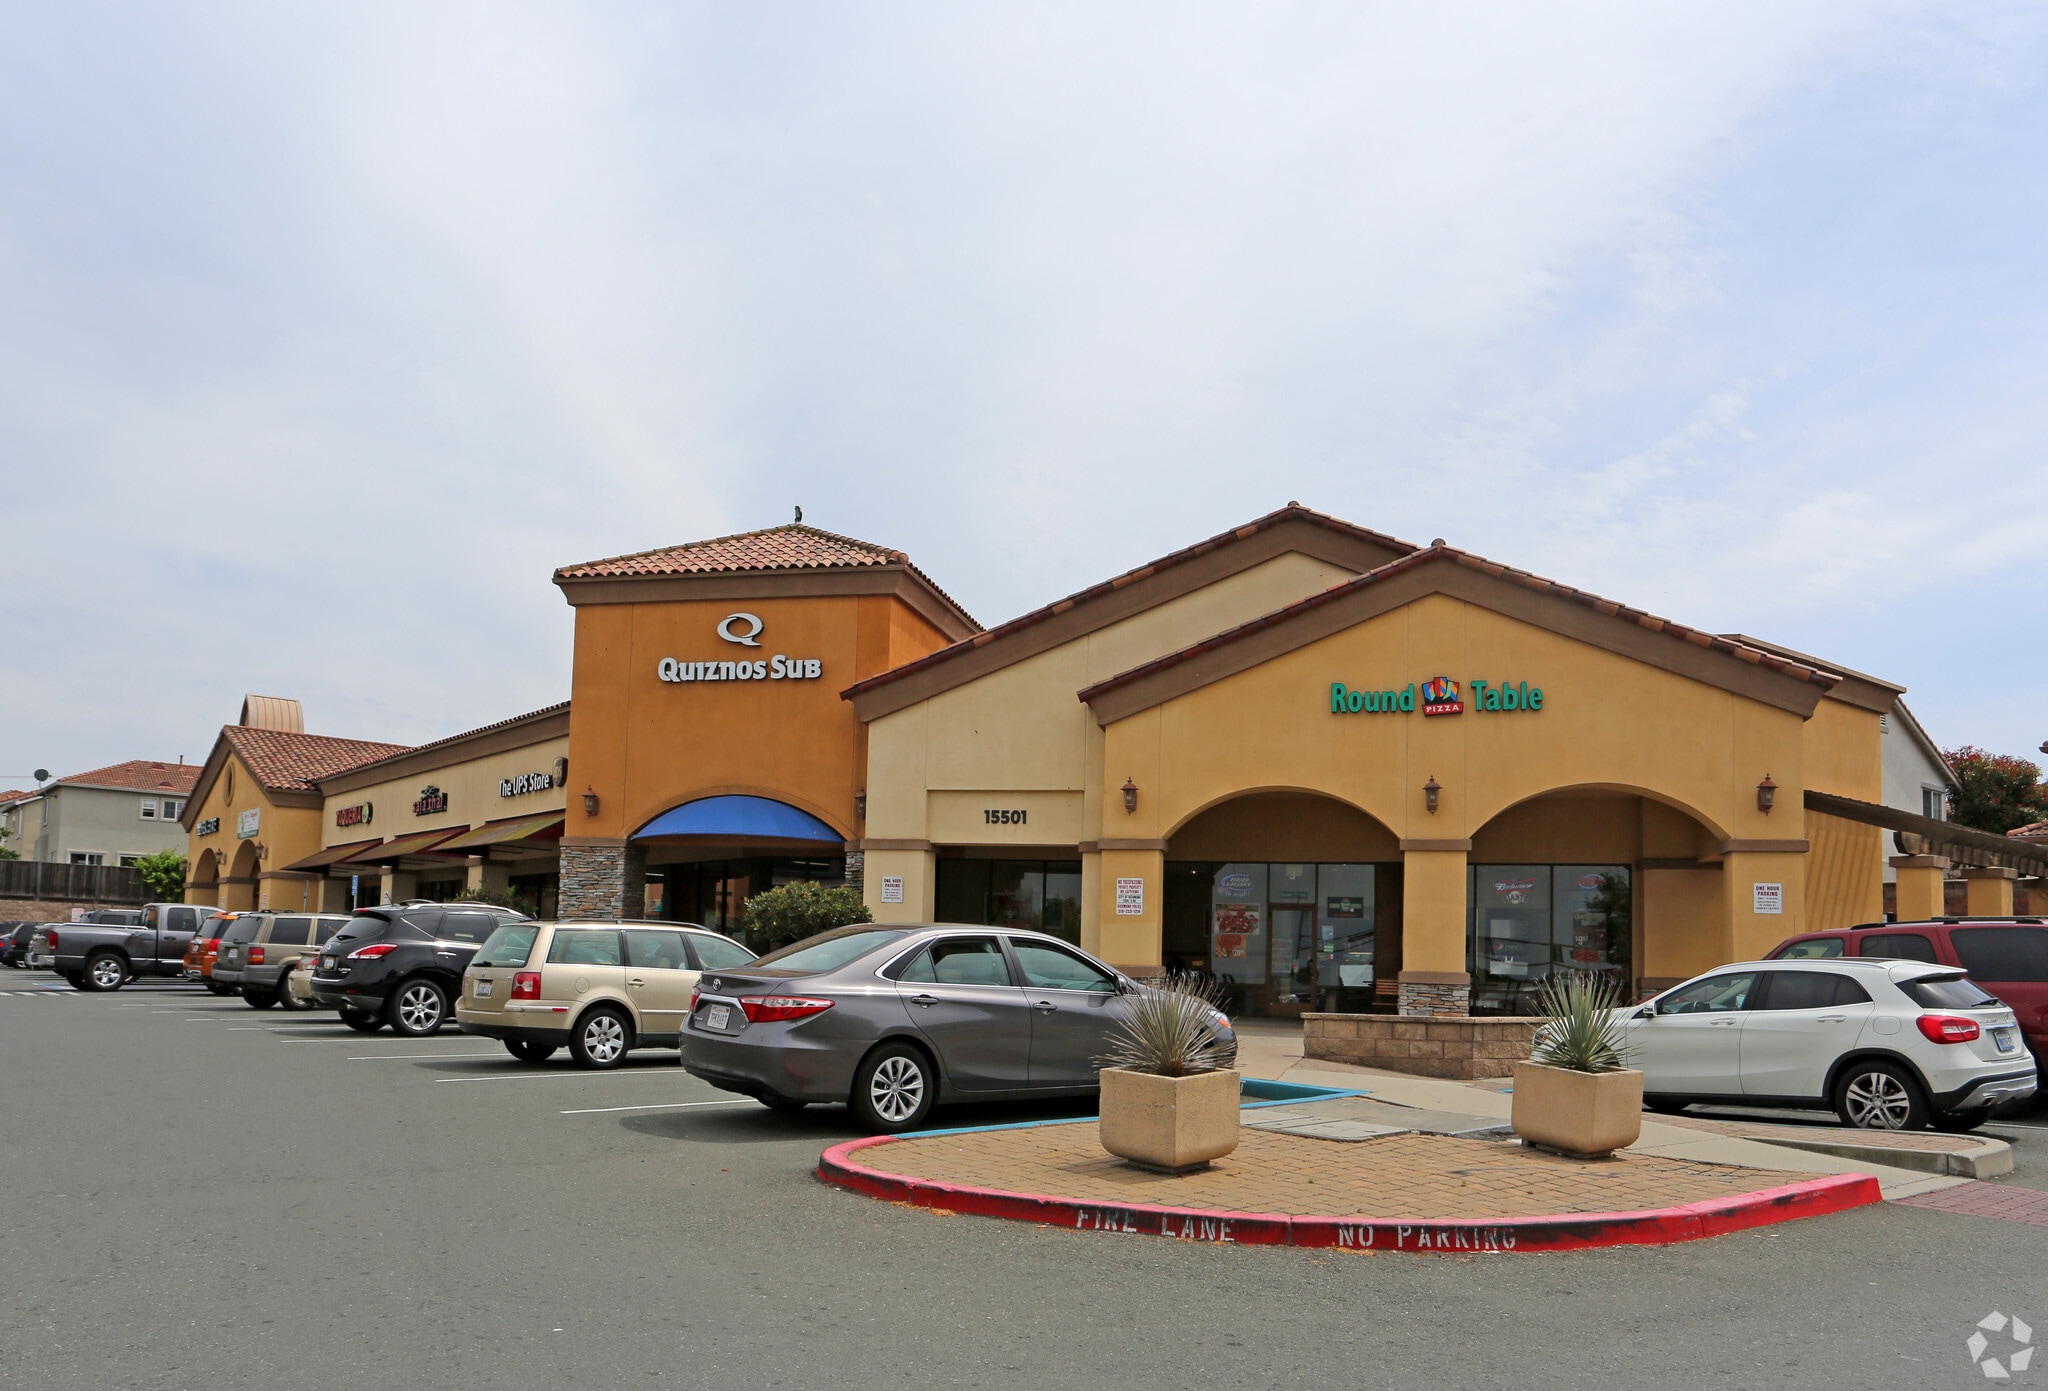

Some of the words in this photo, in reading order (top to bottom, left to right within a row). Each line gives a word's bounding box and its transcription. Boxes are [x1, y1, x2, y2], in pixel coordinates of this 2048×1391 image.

[717, 612, 764, 647] Q
[1331, 683, 1415, 713] Round
[1471, 680, 1544, 712] Table
[1426, 705, 1460, 713] PIZZA
[498, 779, 512, 797] The
[513, 774, 528, 795] UPS
[529, 773, 550, 791] Store
[984, 809, 1027, 824] 15501
[1161, 1212, 1235, 1242] LANE
[1338, 1222, 1374, 1247] NO
[1397, 1224, 1516, 1250] PARKING
